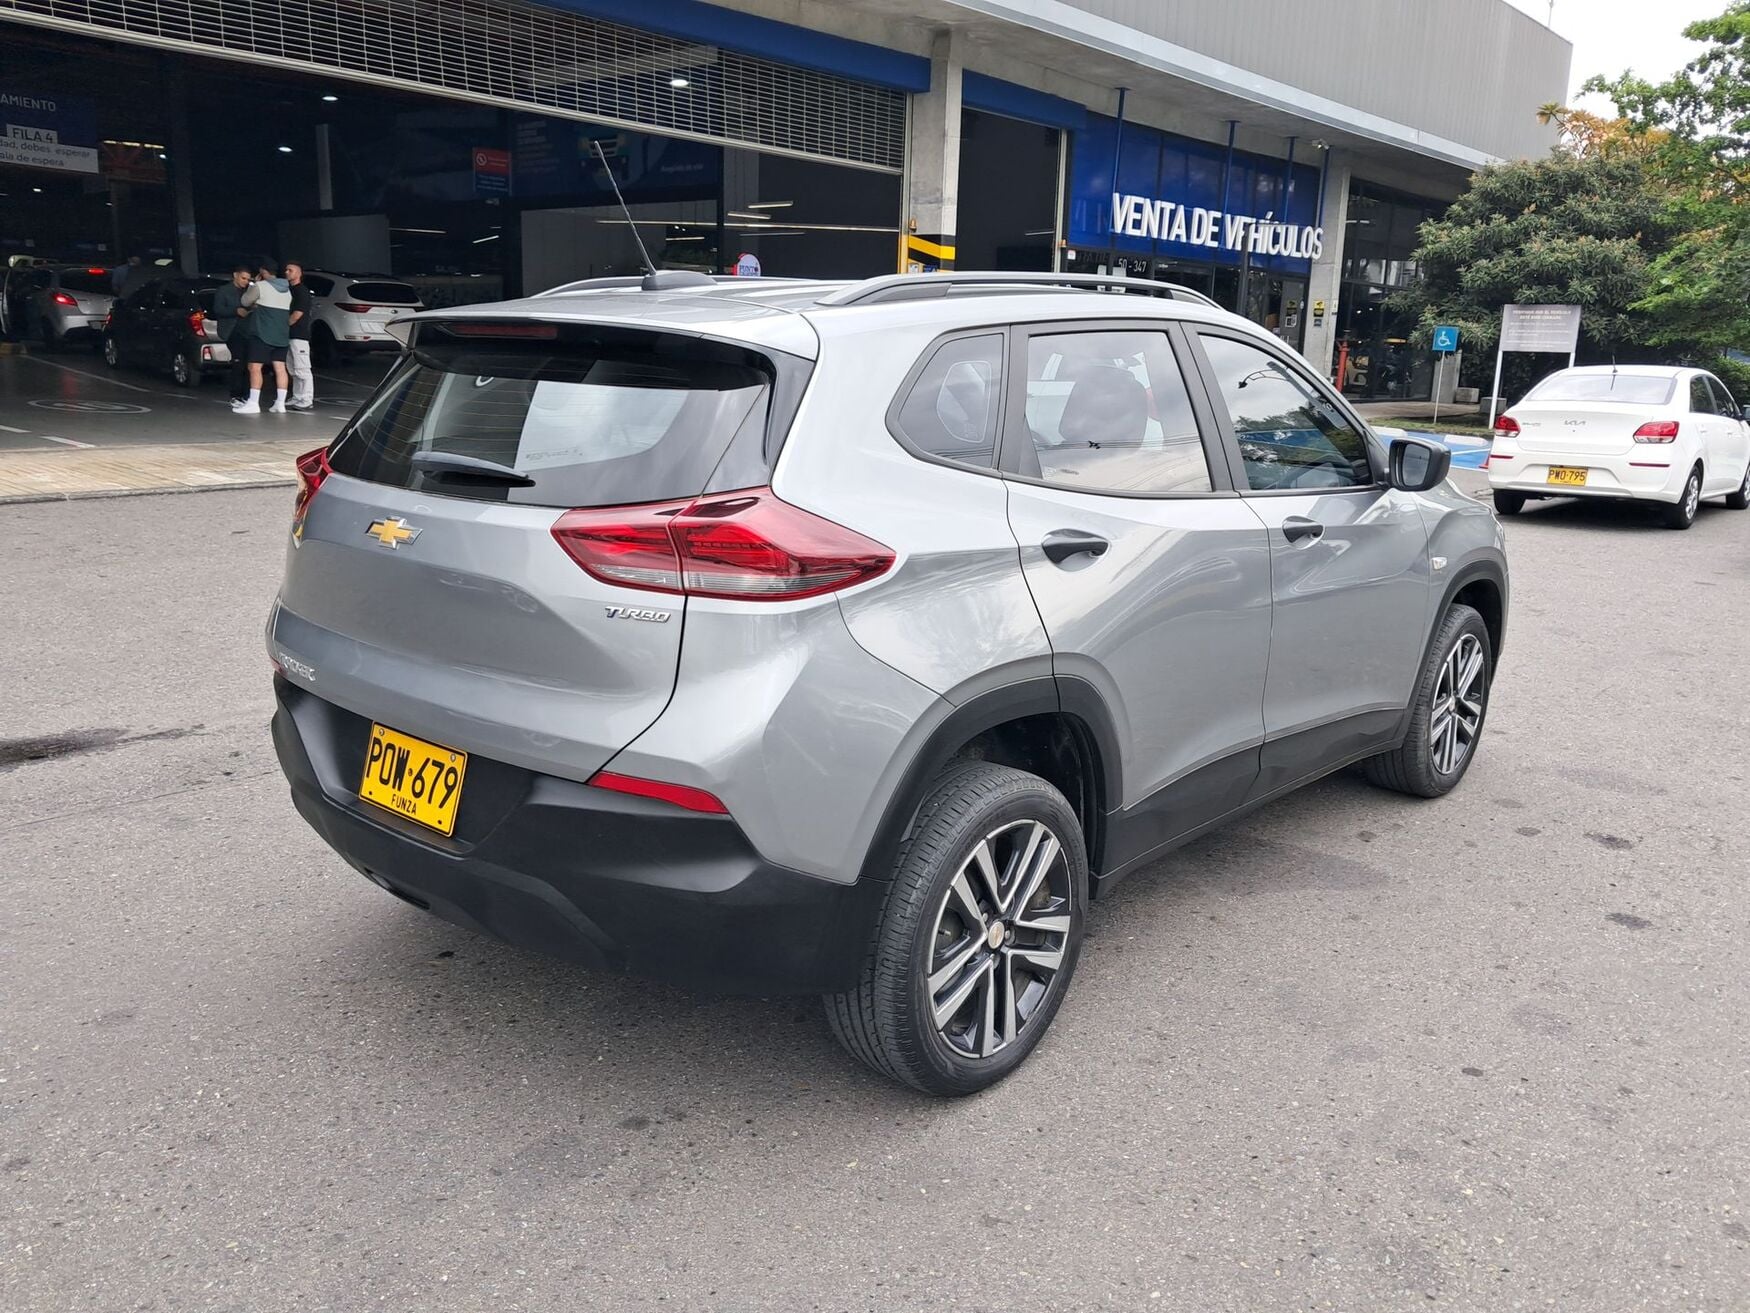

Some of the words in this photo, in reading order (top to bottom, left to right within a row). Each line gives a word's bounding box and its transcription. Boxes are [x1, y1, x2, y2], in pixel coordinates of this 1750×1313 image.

[12, 128, 42, 142] FILA
[46, 133, 53, 143] 4
[16, 153, 30, 162] de
[32, 157, 64, 167] espera
[1112, 192, 1187, 243] VENTA
[1190, 207, 1222, 248] DE
[1224, 211, 1324, 260] VEHÍCULOS
[1133, 261, 1146, 273] 347
[605, 606, 671, 623] TURBO
[391, 794, 417, 815] FUNZA
